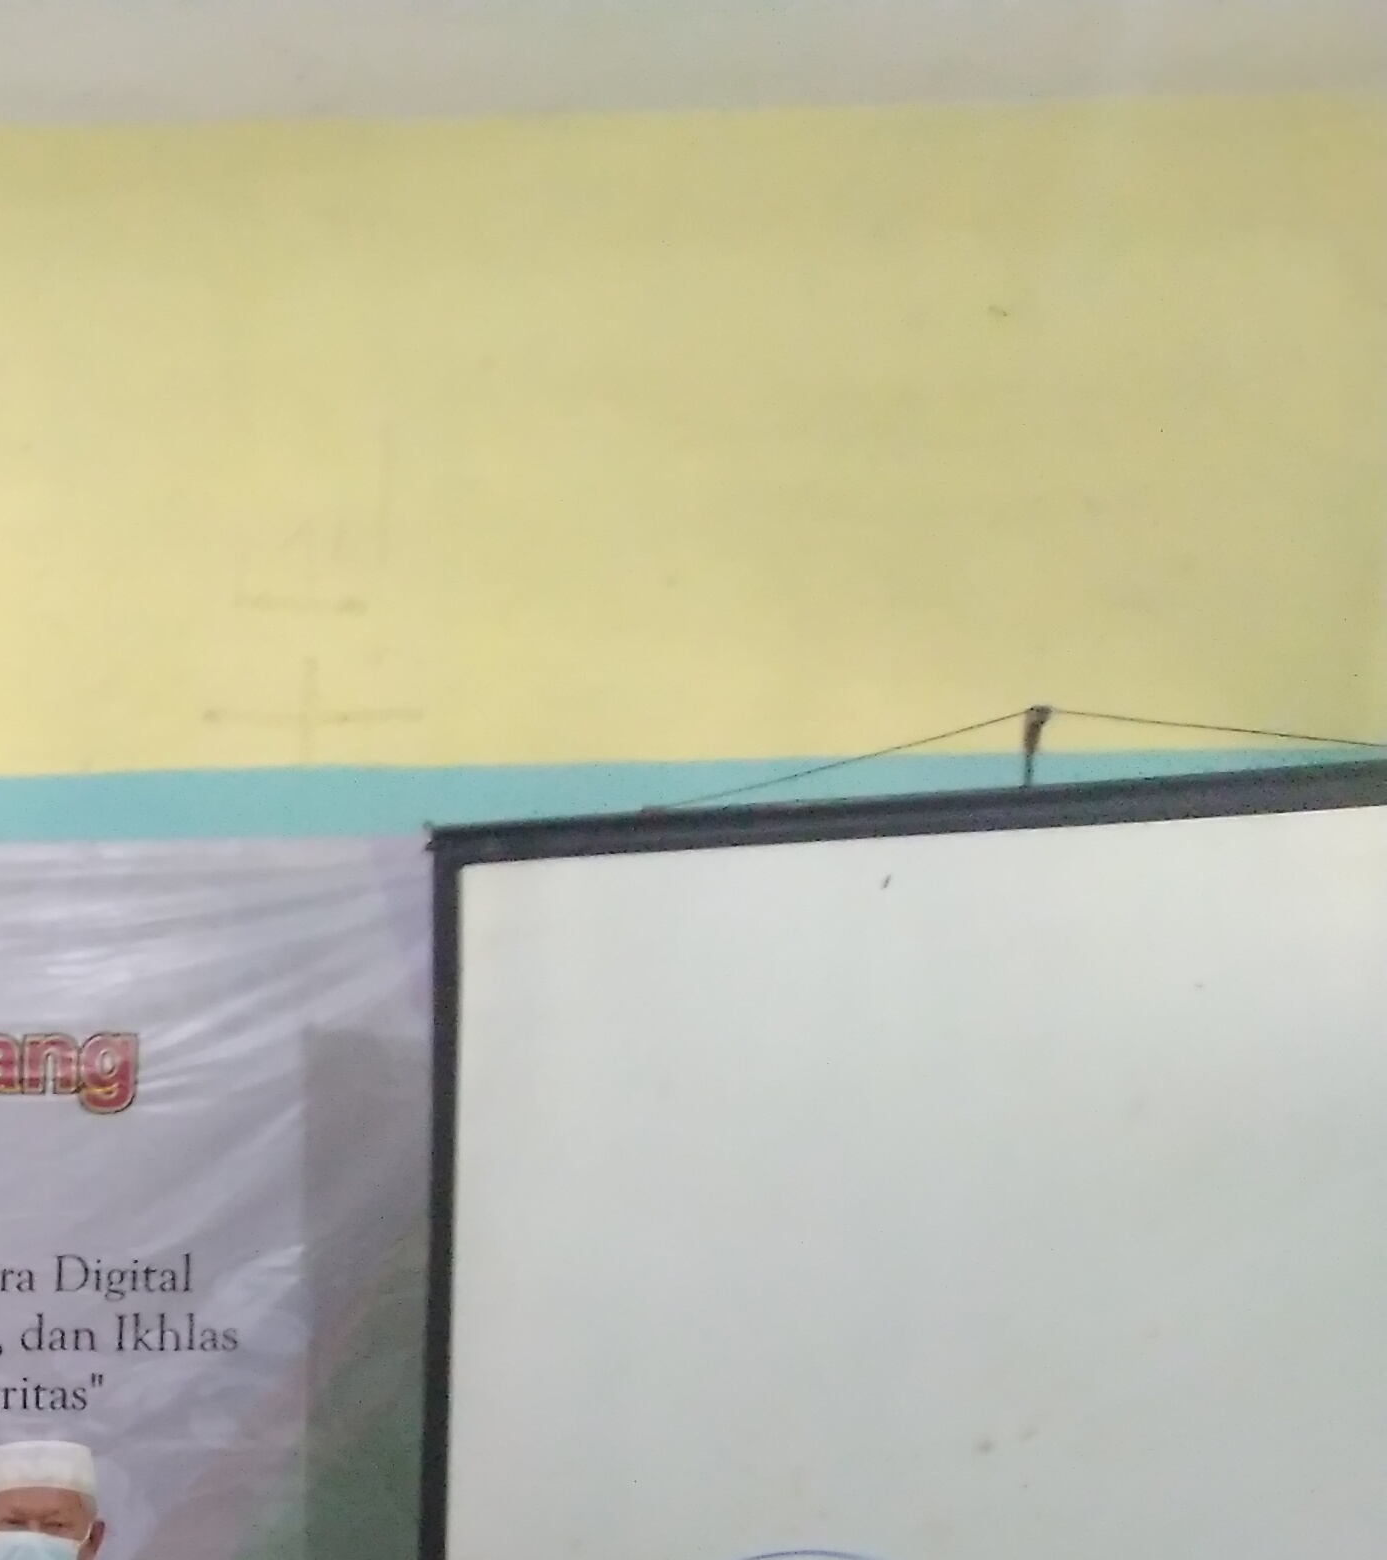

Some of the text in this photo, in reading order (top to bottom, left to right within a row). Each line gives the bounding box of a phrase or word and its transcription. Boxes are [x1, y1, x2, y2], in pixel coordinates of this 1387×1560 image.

[55, 1252, 194, 1302] Digital
[20, 1313, 98, 1352] dan
[116, 1312, 240, 1353] Ikhlas
